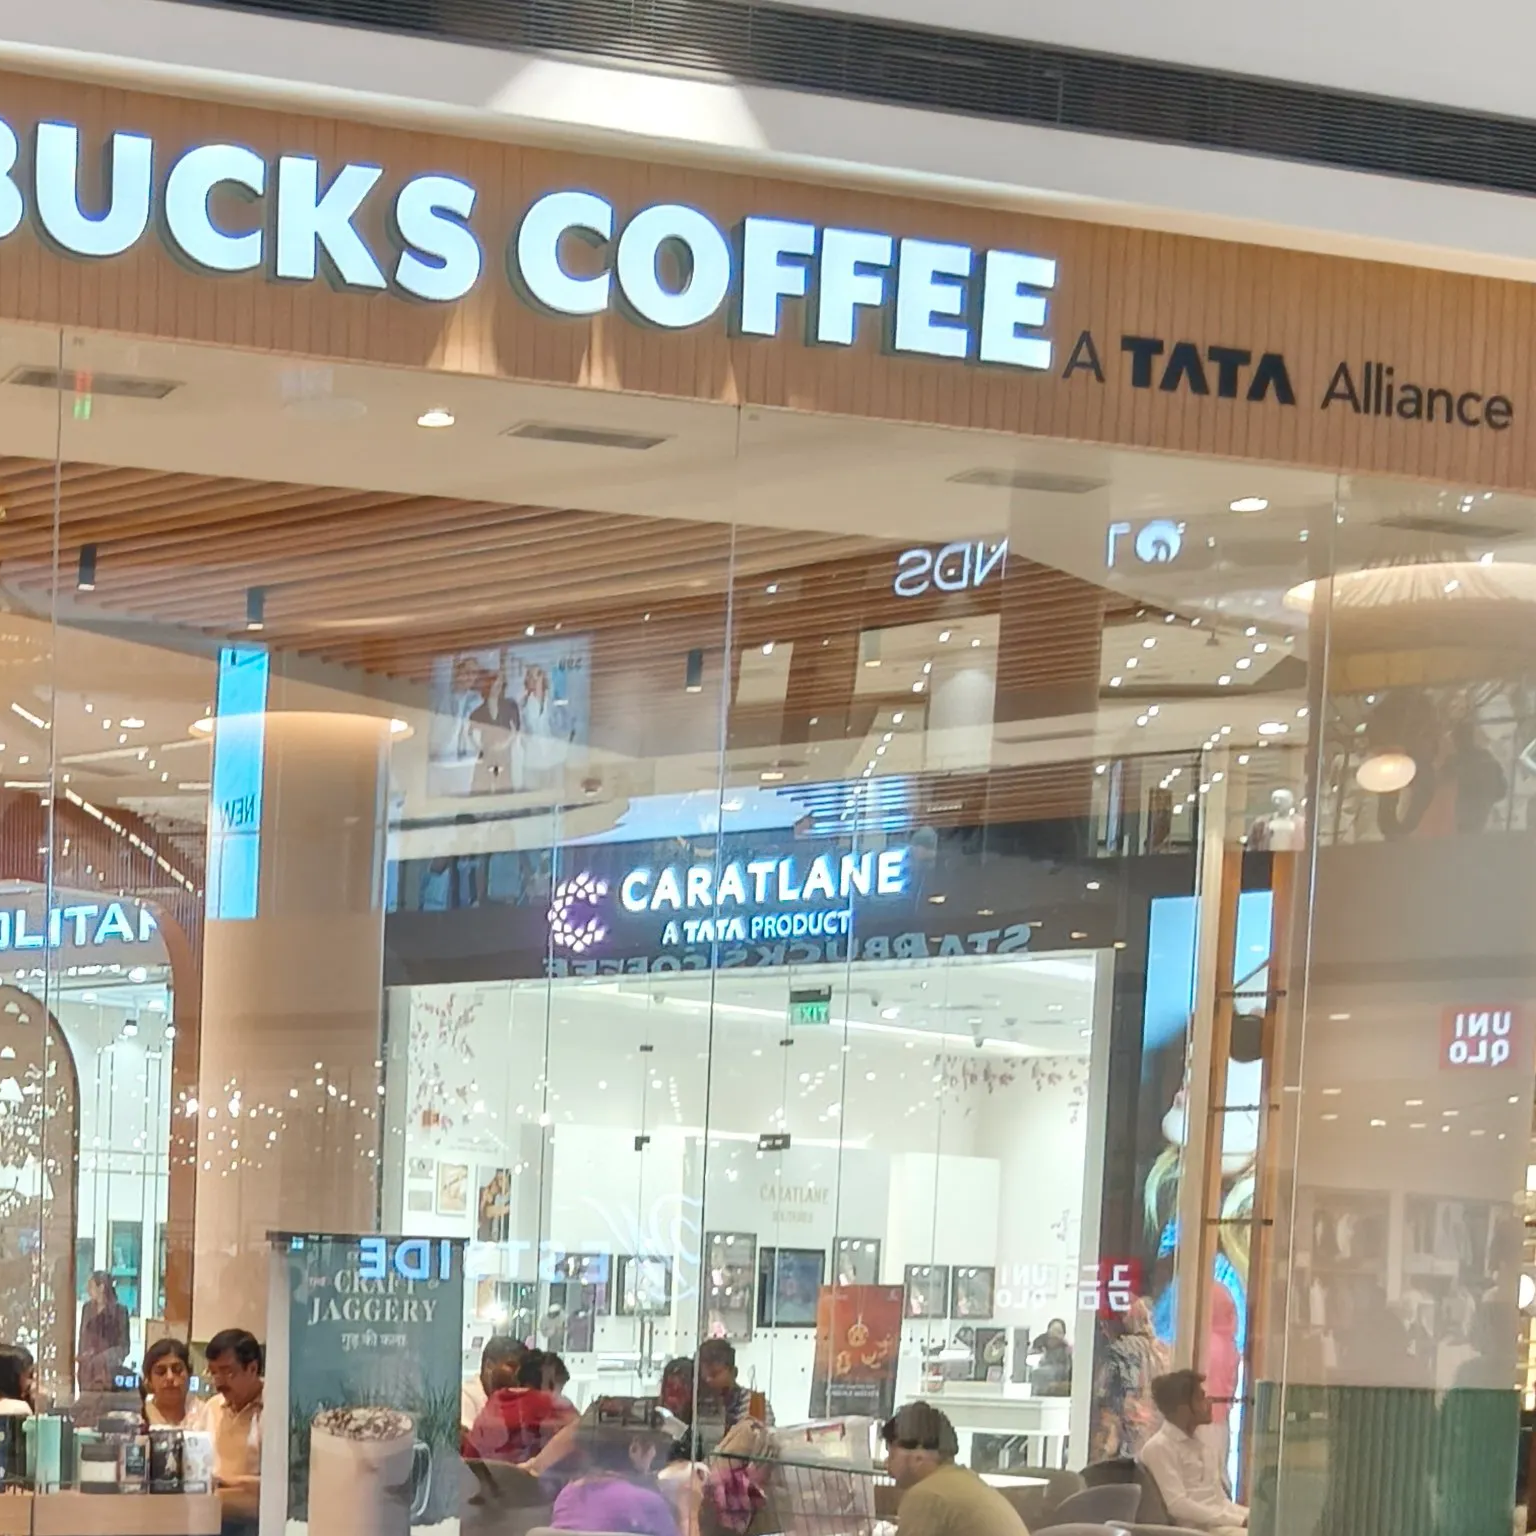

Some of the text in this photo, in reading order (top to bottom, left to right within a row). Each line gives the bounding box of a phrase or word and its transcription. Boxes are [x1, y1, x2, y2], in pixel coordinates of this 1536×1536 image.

[515, 189, 1058, 372] COFFEE
[1063, 330, 1514, 431] A TATA Alliance
[621, 848, 908, 913] CARATLANE
[663, 909, 852, 945] A TATA PRODUCT
[307, 1297, 437, 1326] JAGGERY
